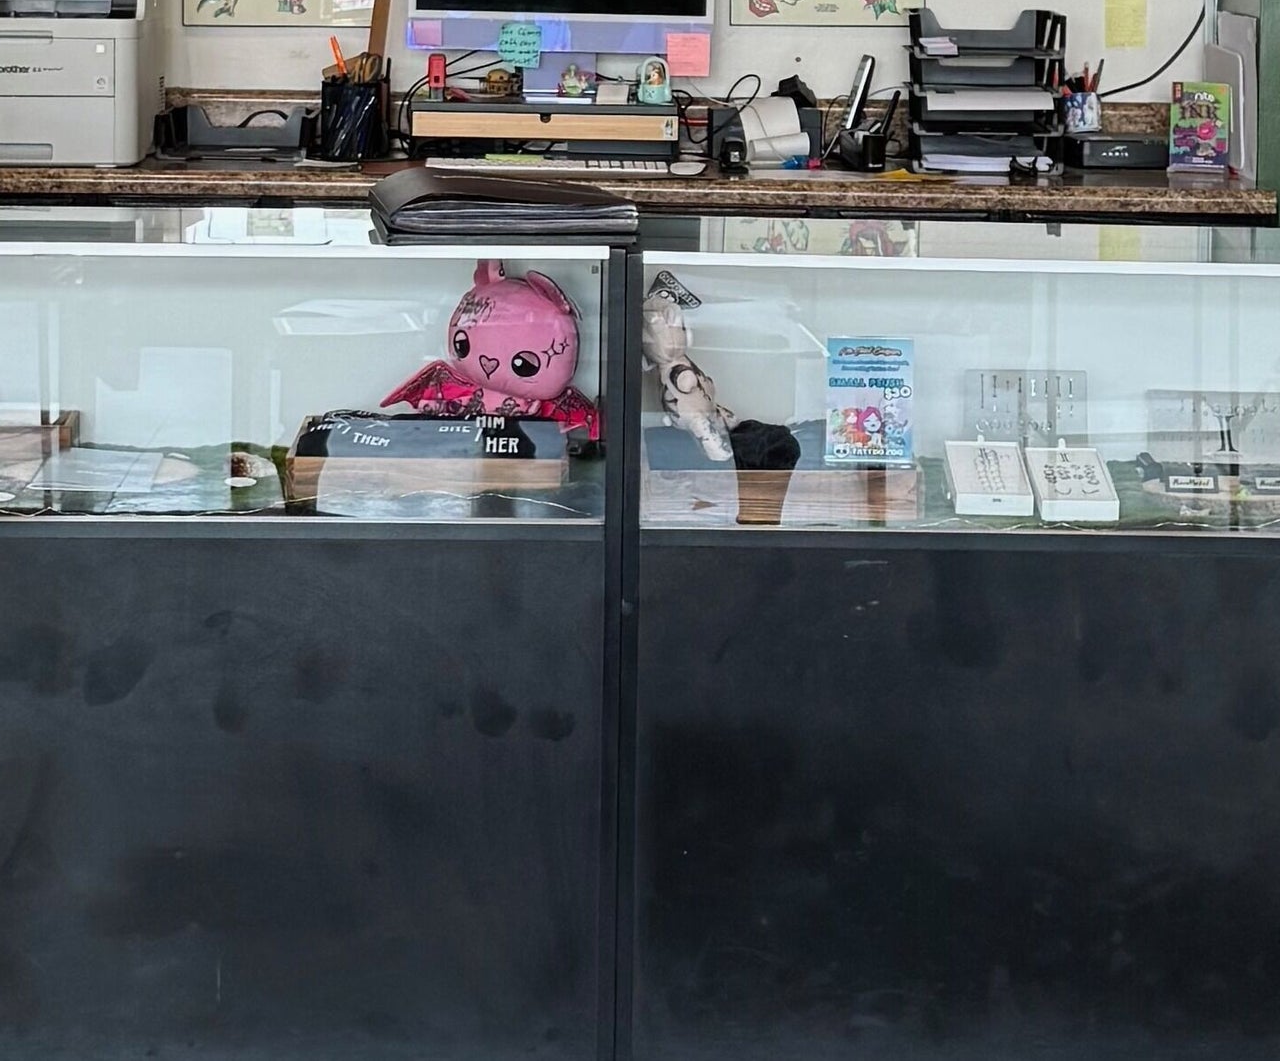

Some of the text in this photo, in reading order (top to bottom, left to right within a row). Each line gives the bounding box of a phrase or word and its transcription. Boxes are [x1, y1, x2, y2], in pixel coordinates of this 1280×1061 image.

[353, 432, 391, 447] THEM
[485, 437, 520, 453] HER
[852, 447, 903, 456] TATTOO ZOO
